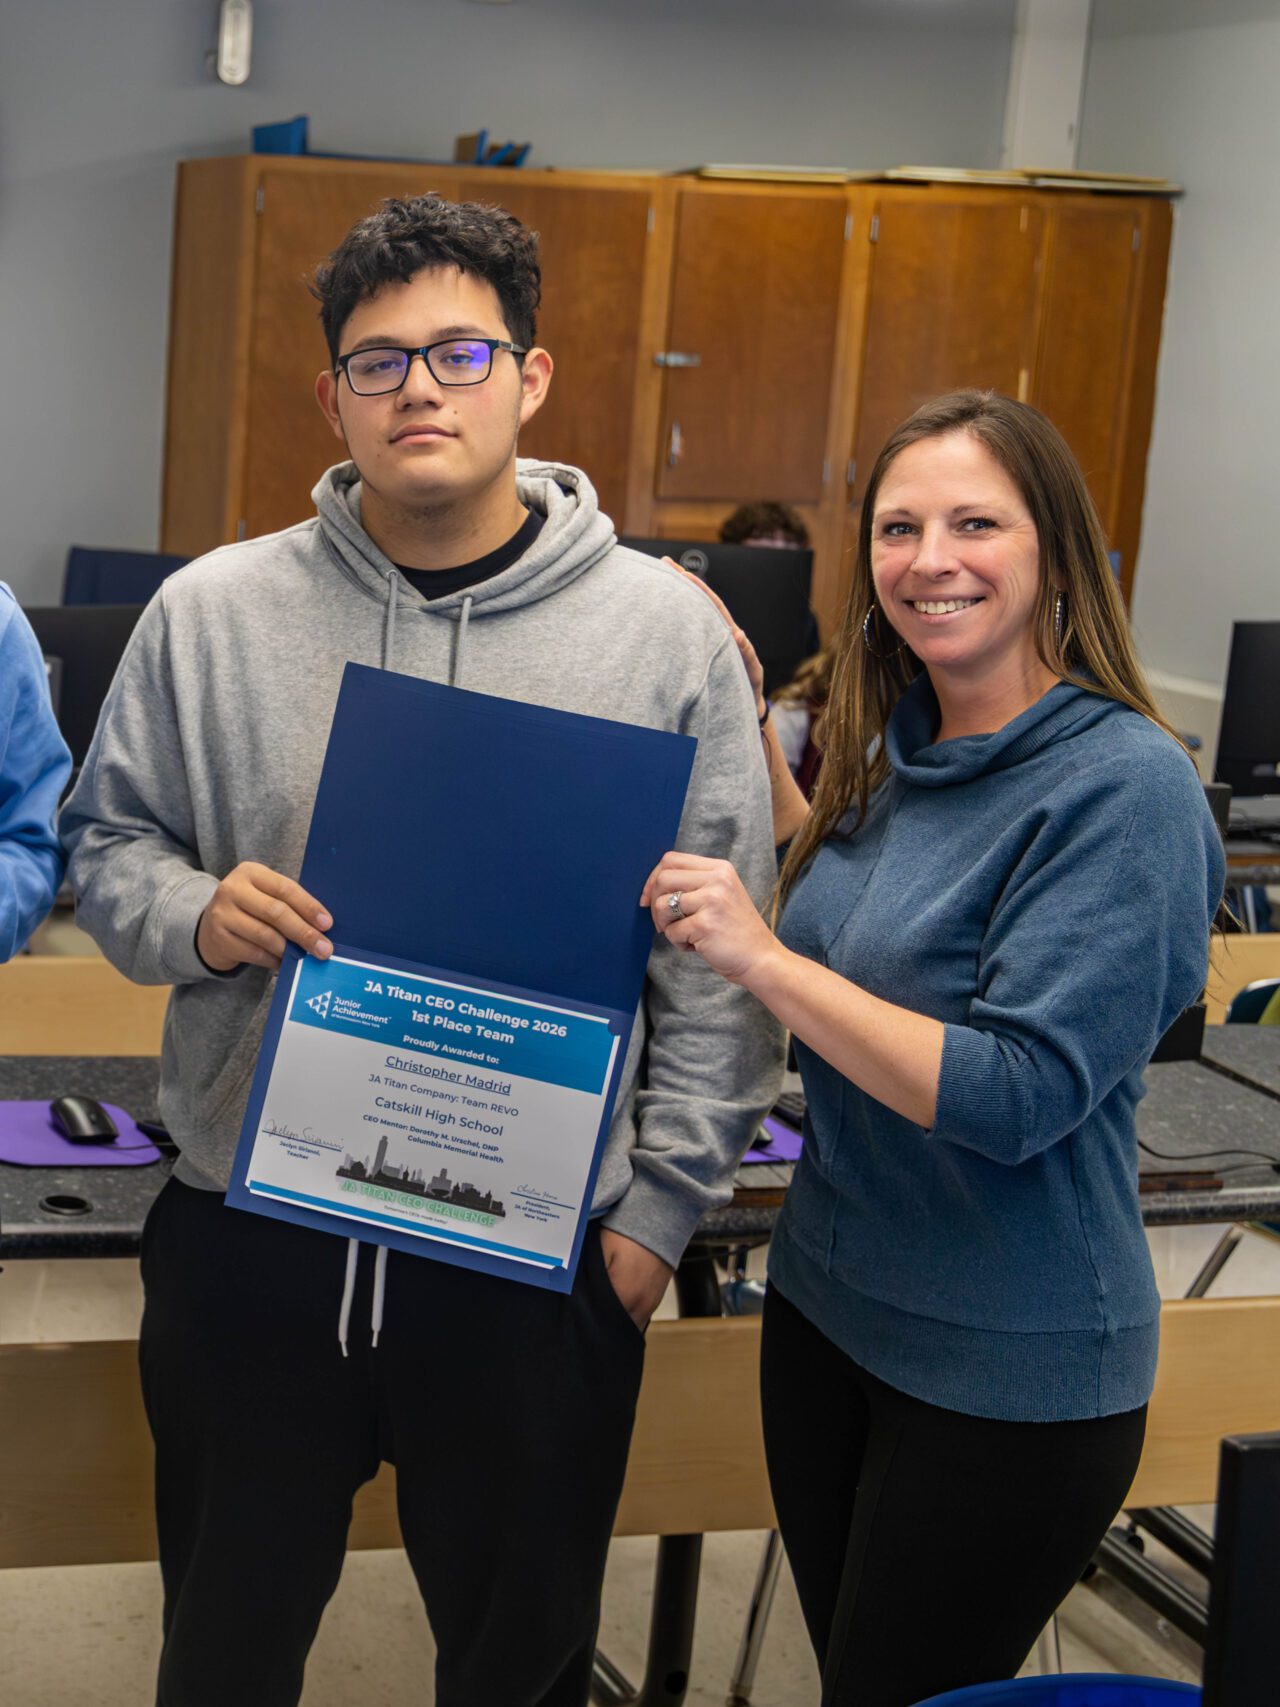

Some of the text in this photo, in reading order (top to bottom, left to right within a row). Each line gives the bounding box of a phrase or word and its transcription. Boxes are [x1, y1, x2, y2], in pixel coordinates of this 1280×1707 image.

[334, 997, 361, 1009] Junior
[364, 980, 567, 1038] JA Titan CEO Challenge 2026
[411, 1010, 515, 1044] 1st Place Team
[403, 1034, 500, 1065] Proudly Awarded to:
[385, 1056, 512, 1096] Christopher Madrid
[368, 1074, 519, 1117] JA Titan Company: Team REVO
[363, 1114, 499, 1152] CEO Mentor: Dorothy M. Urschel, DNP
[375, 1096, 504, 1137] Catskill High School
[287, 1150, 309, 1160] Teacher
[407, 1135, 504, 1164] Columbia Memorial Health
[360, 1184, 396, 1203] TITAN
[398, 1196, 424, 1210] CEO
[426, 1202, 497, 1227] CHALLENGE
